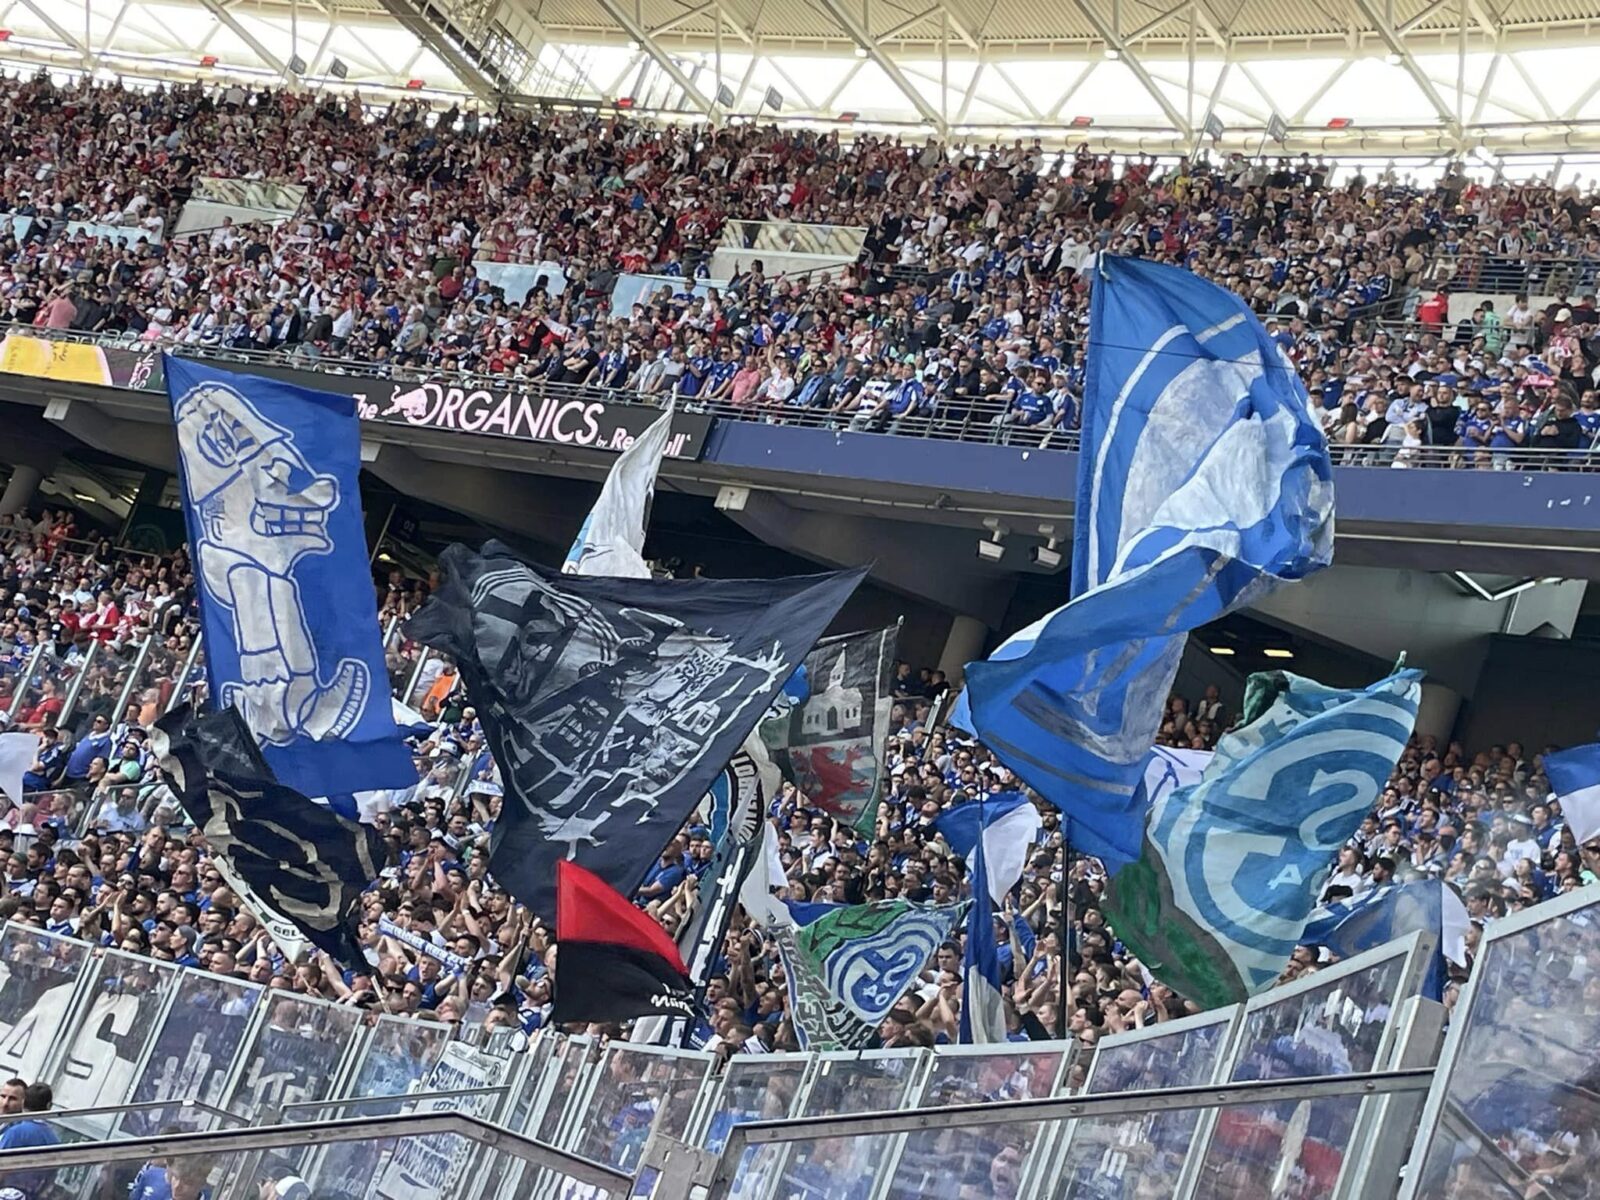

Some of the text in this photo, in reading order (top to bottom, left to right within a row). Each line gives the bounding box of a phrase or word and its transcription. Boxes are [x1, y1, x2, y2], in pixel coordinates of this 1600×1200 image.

[352, 383, 685, 456] The ORGANICS by Re ull
